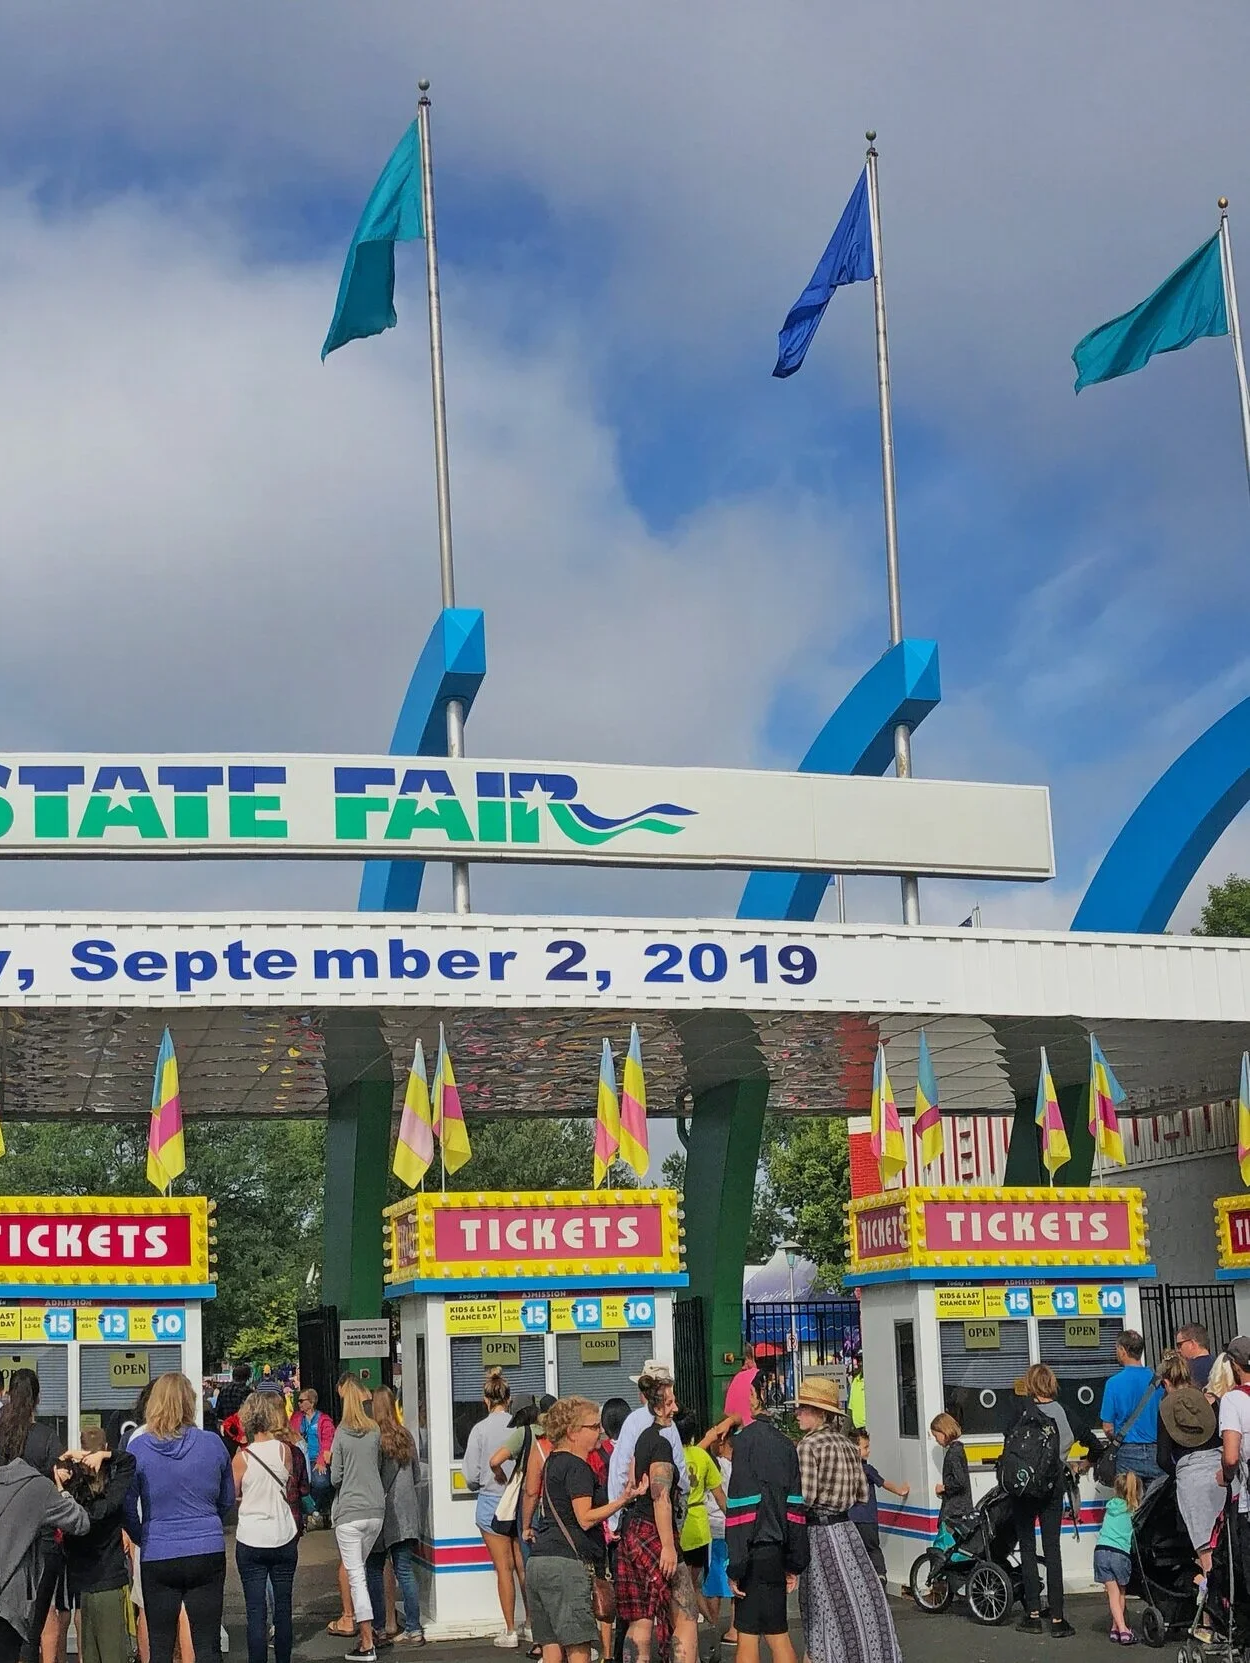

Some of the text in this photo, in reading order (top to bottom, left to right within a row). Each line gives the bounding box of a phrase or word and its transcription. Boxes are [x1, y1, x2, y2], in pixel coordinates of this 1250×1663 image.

[334, 767, 620, 845] FAIR
[71, 938, 517, 992] September
[545, 940, 612, 992] 2,
[643, 943, 817, 985] 2019
[460, 1216, 640, 1251] TICKETS
[945, 1212, 1109, 1242] TICKETS
[522, 1290, 566, 1298] ADMISSION
[1004, 1292, 1029, 1310] $15
[1052, 1291, 1076, 1309] $13
[1098, 1291, 1122, 1308] $10
[450, 1305, 468, 1313] KIDS
[469, 1305, 475, 1313] &
[450, 1312, 497, 1321] CHANCE DAY
[521, 1306, 546, 1324] $15
[571, 1304, 599, 1323] $13
[623, 1302, 651, 1321] $10
[44, 1314, 72, 1333] $15
[98, 1314, 126, 1333] $13
[152, 1314, 181, 1333] $10
[968, 1327, 996, 1338] OPEN
[1068, 1326, 1096, 1336] OPEN
[486, 1343, 516, 1354] OPEN
[585, 1340, 616, 1348] CLOSED
[113, 1363, 147, 1376] OPEN
